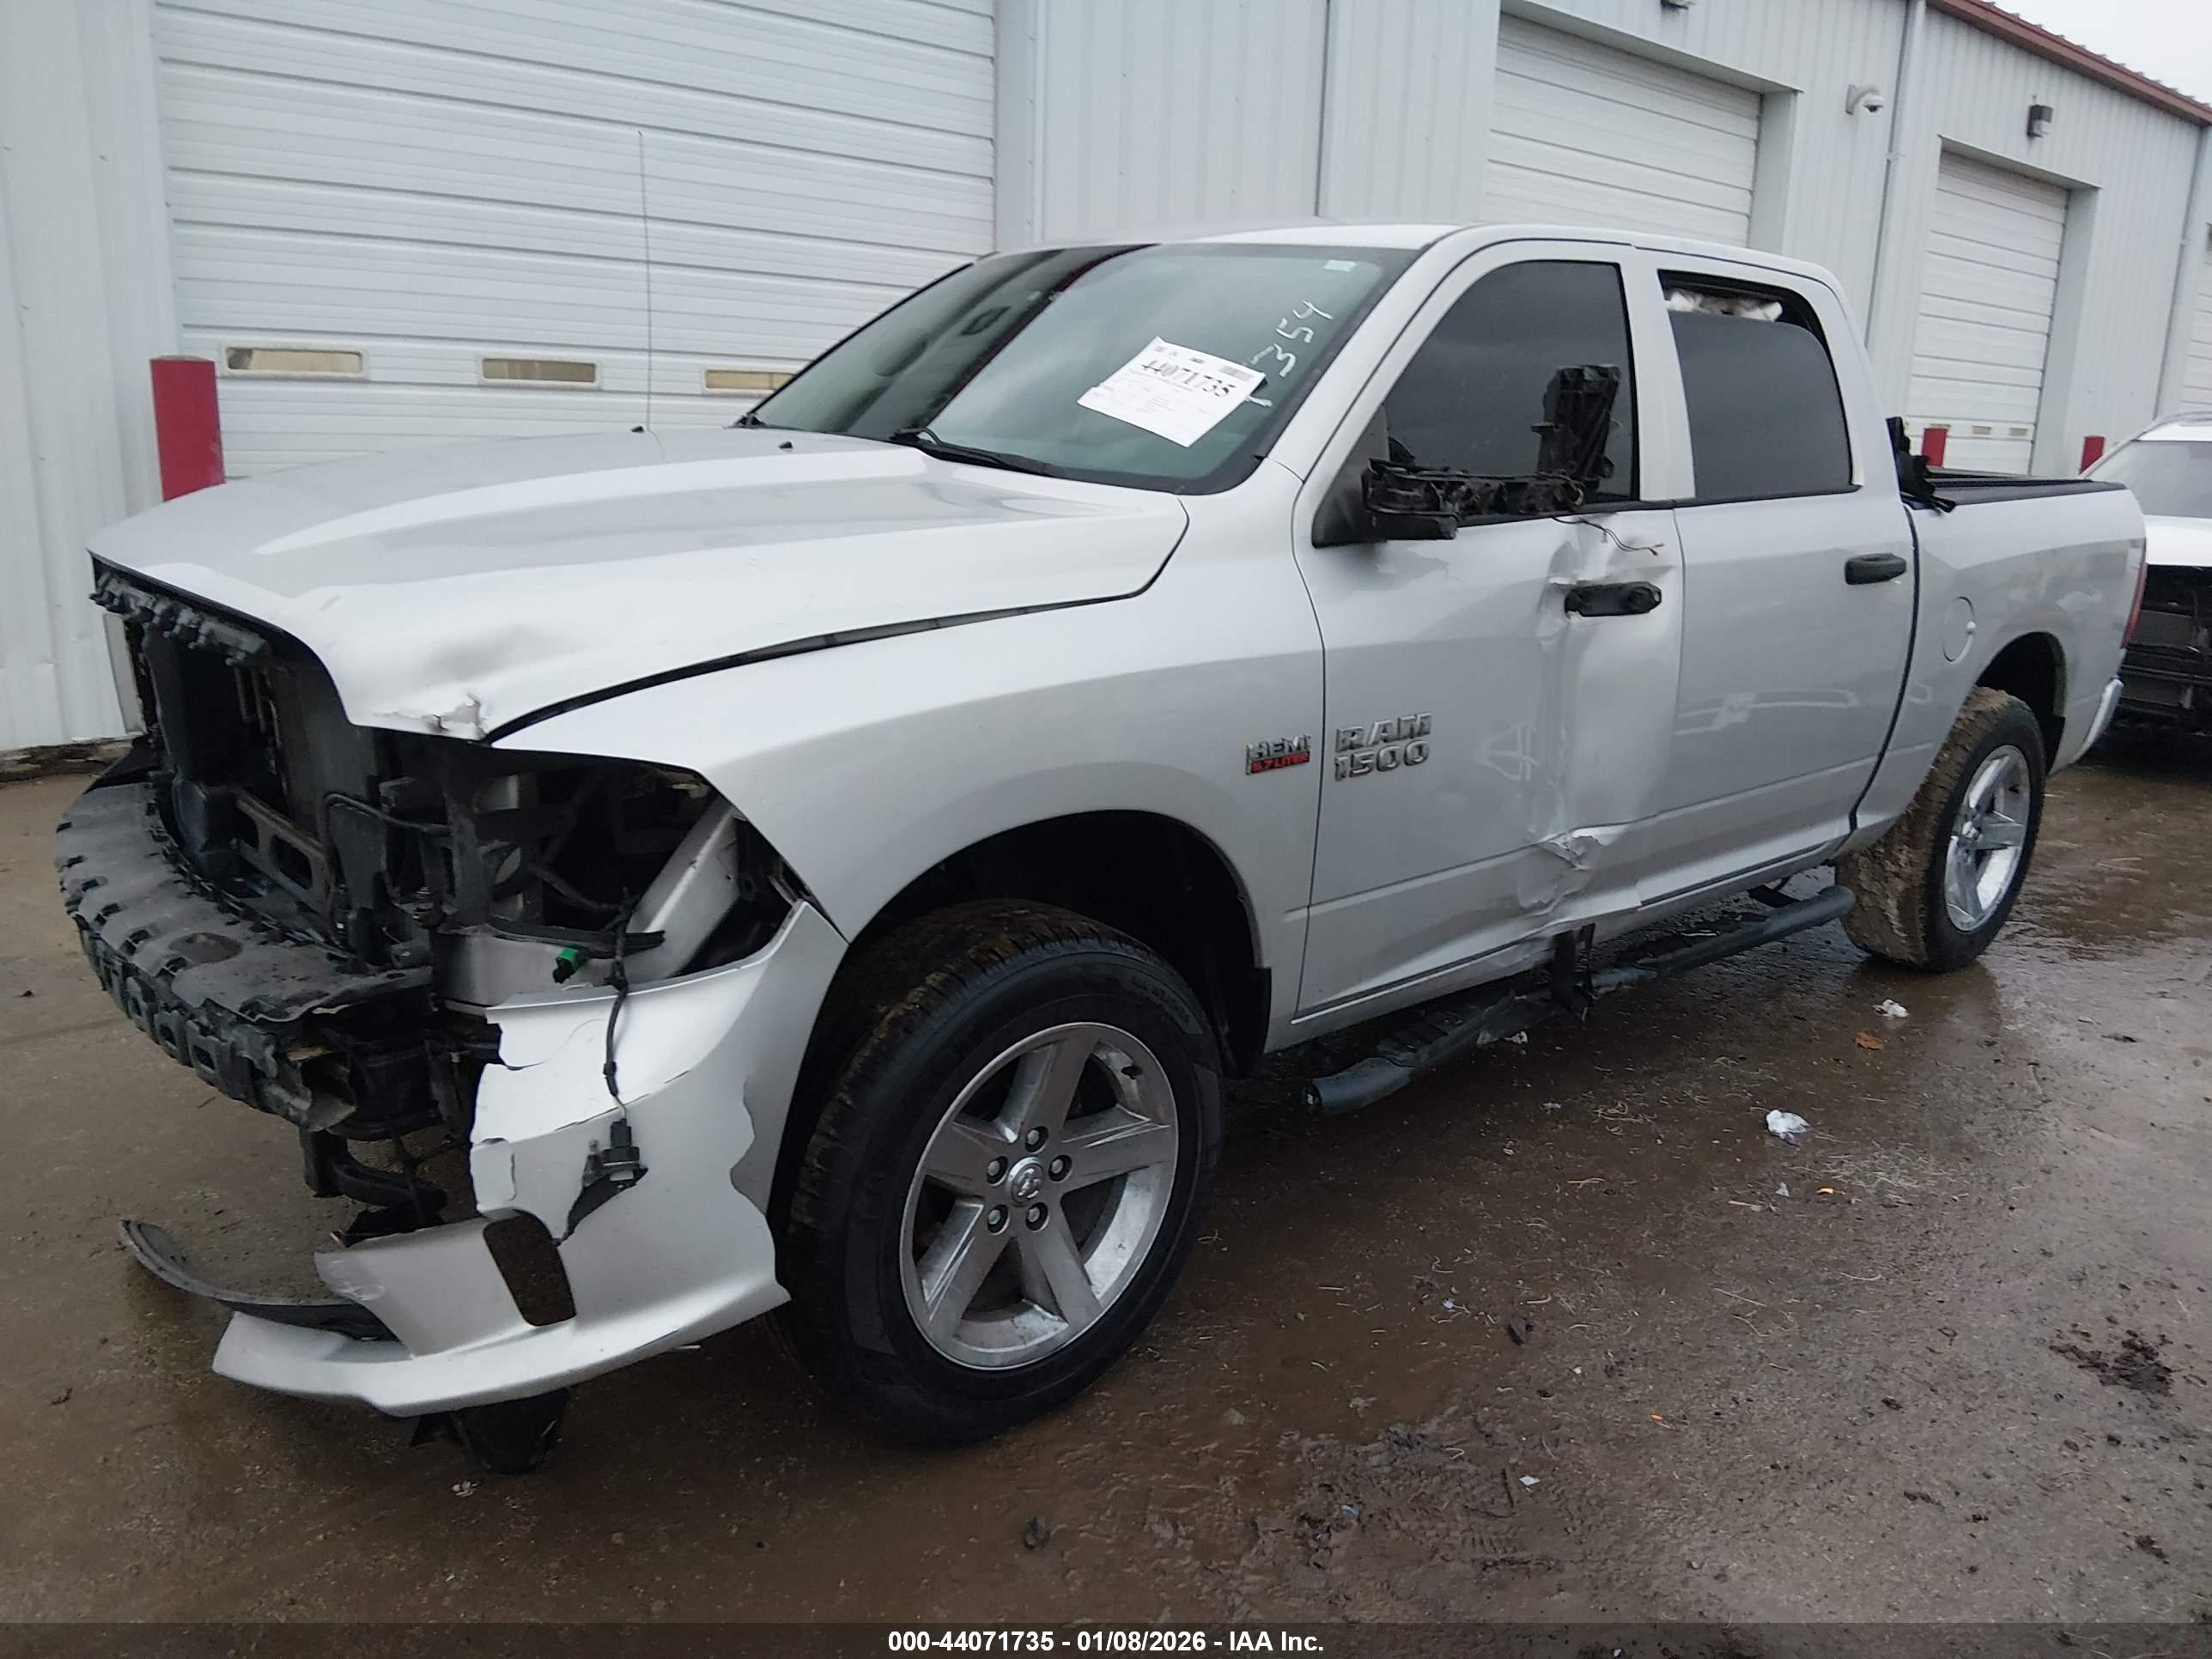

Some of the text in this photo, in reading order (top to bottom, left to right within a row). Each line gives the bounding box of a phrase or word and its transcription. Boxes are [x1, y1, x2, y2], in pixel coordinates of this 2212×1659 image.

[1245, 734, 1310, 762] HEMI
[1335, 713, 1432, 753] RAM
[1334, 740, 1431, 781] 1500
